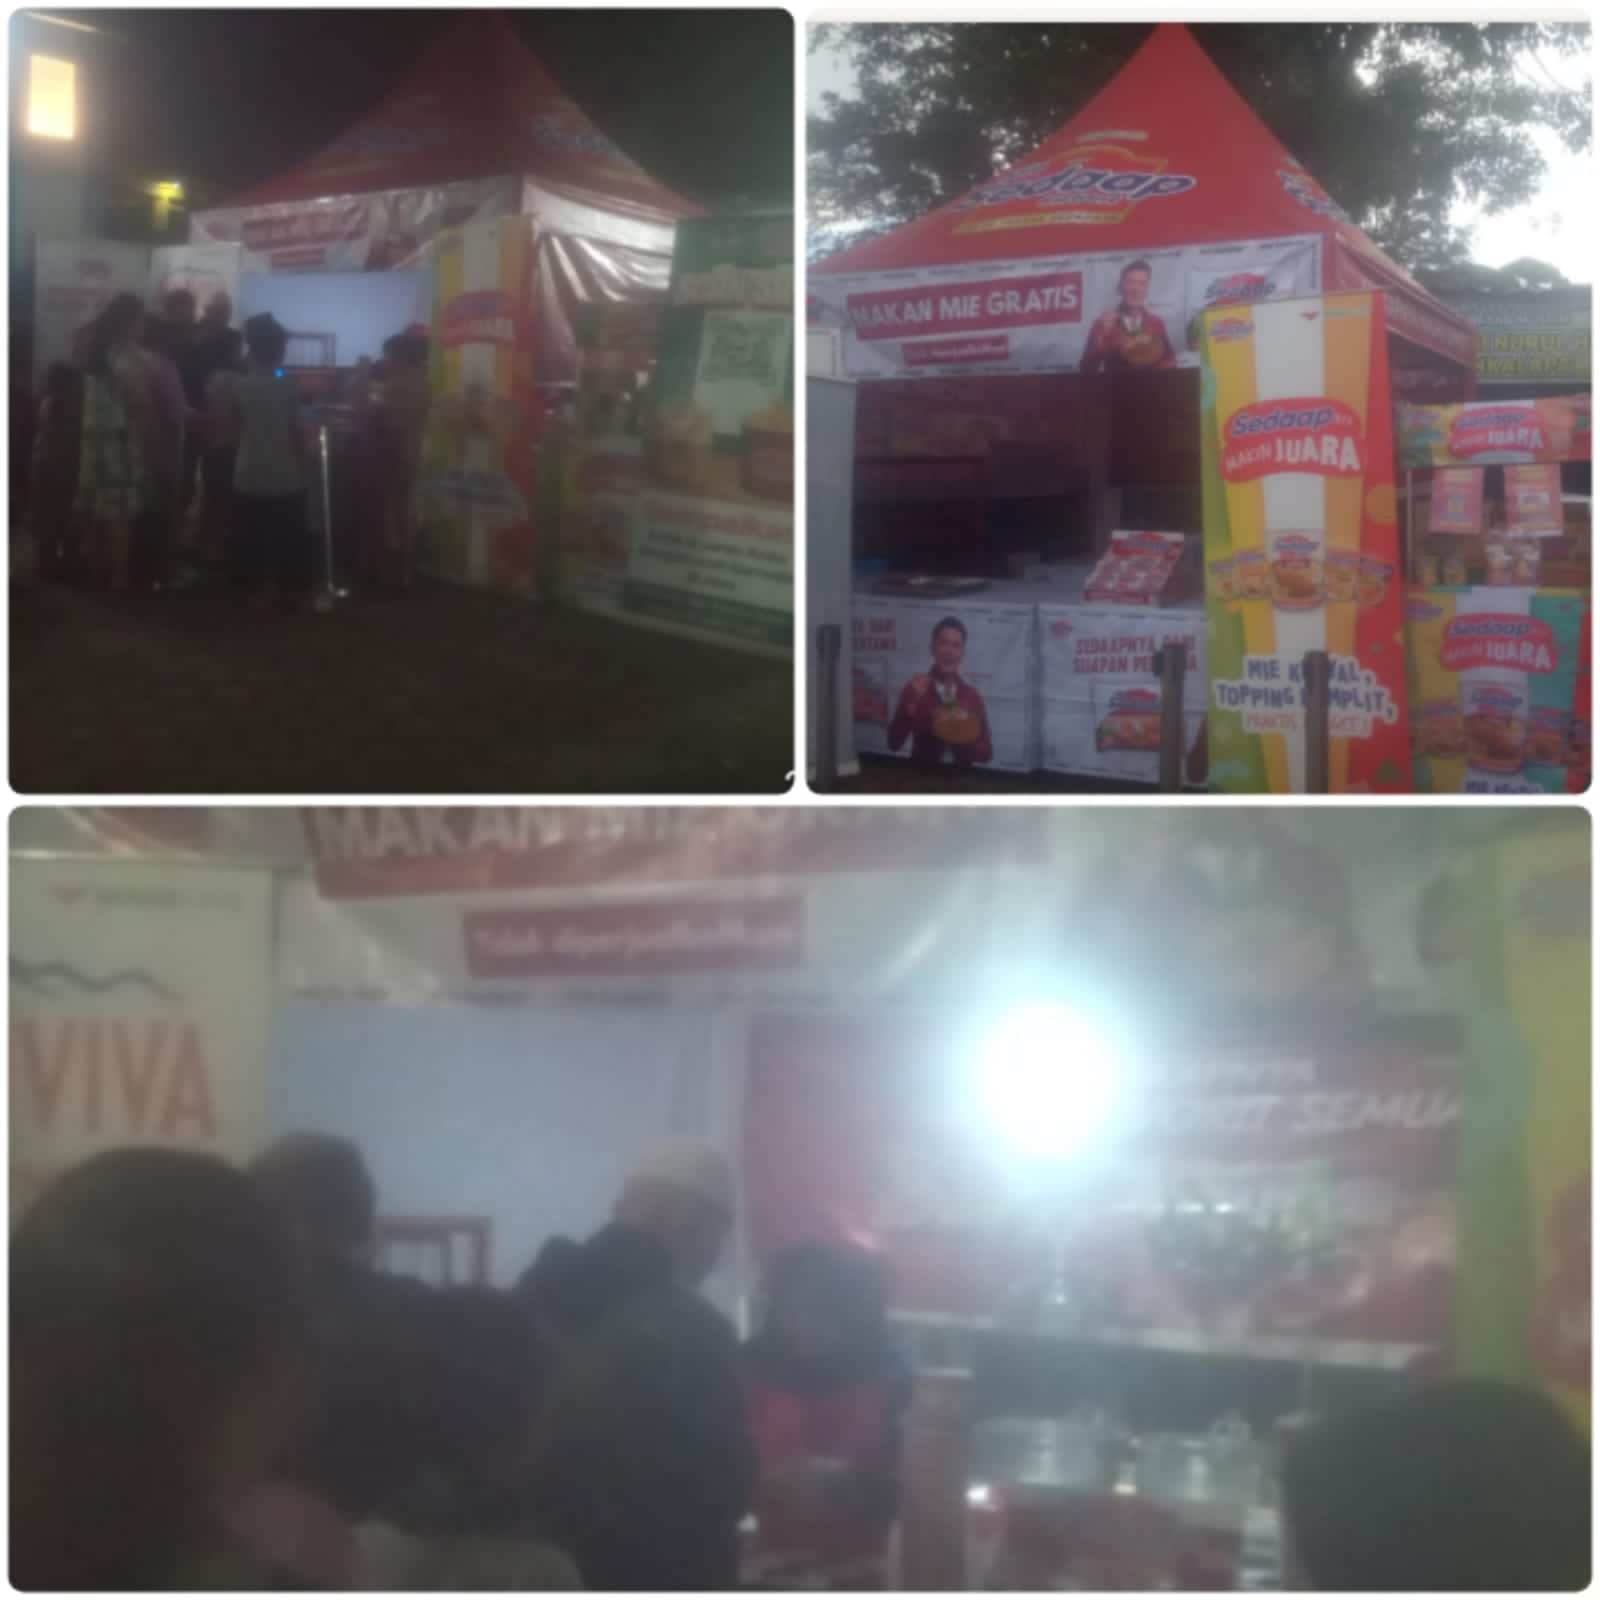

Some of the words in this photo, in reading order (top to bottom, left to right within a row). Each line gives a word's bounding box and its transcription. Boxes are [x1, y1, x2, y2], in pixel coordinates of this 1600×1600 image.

[939, 295, 981, 321] MIE
[987, 284, 1078, 316] GRATIS
[1232, 407, 1334, 435] Sedaap
[1275, 434, 1361, 471] JUARA
[1248, 658, 1281, 681] MIE
[1485, 638, 1554, 671] JUARA
[1216, 683, 1295, 709] TOPPING
